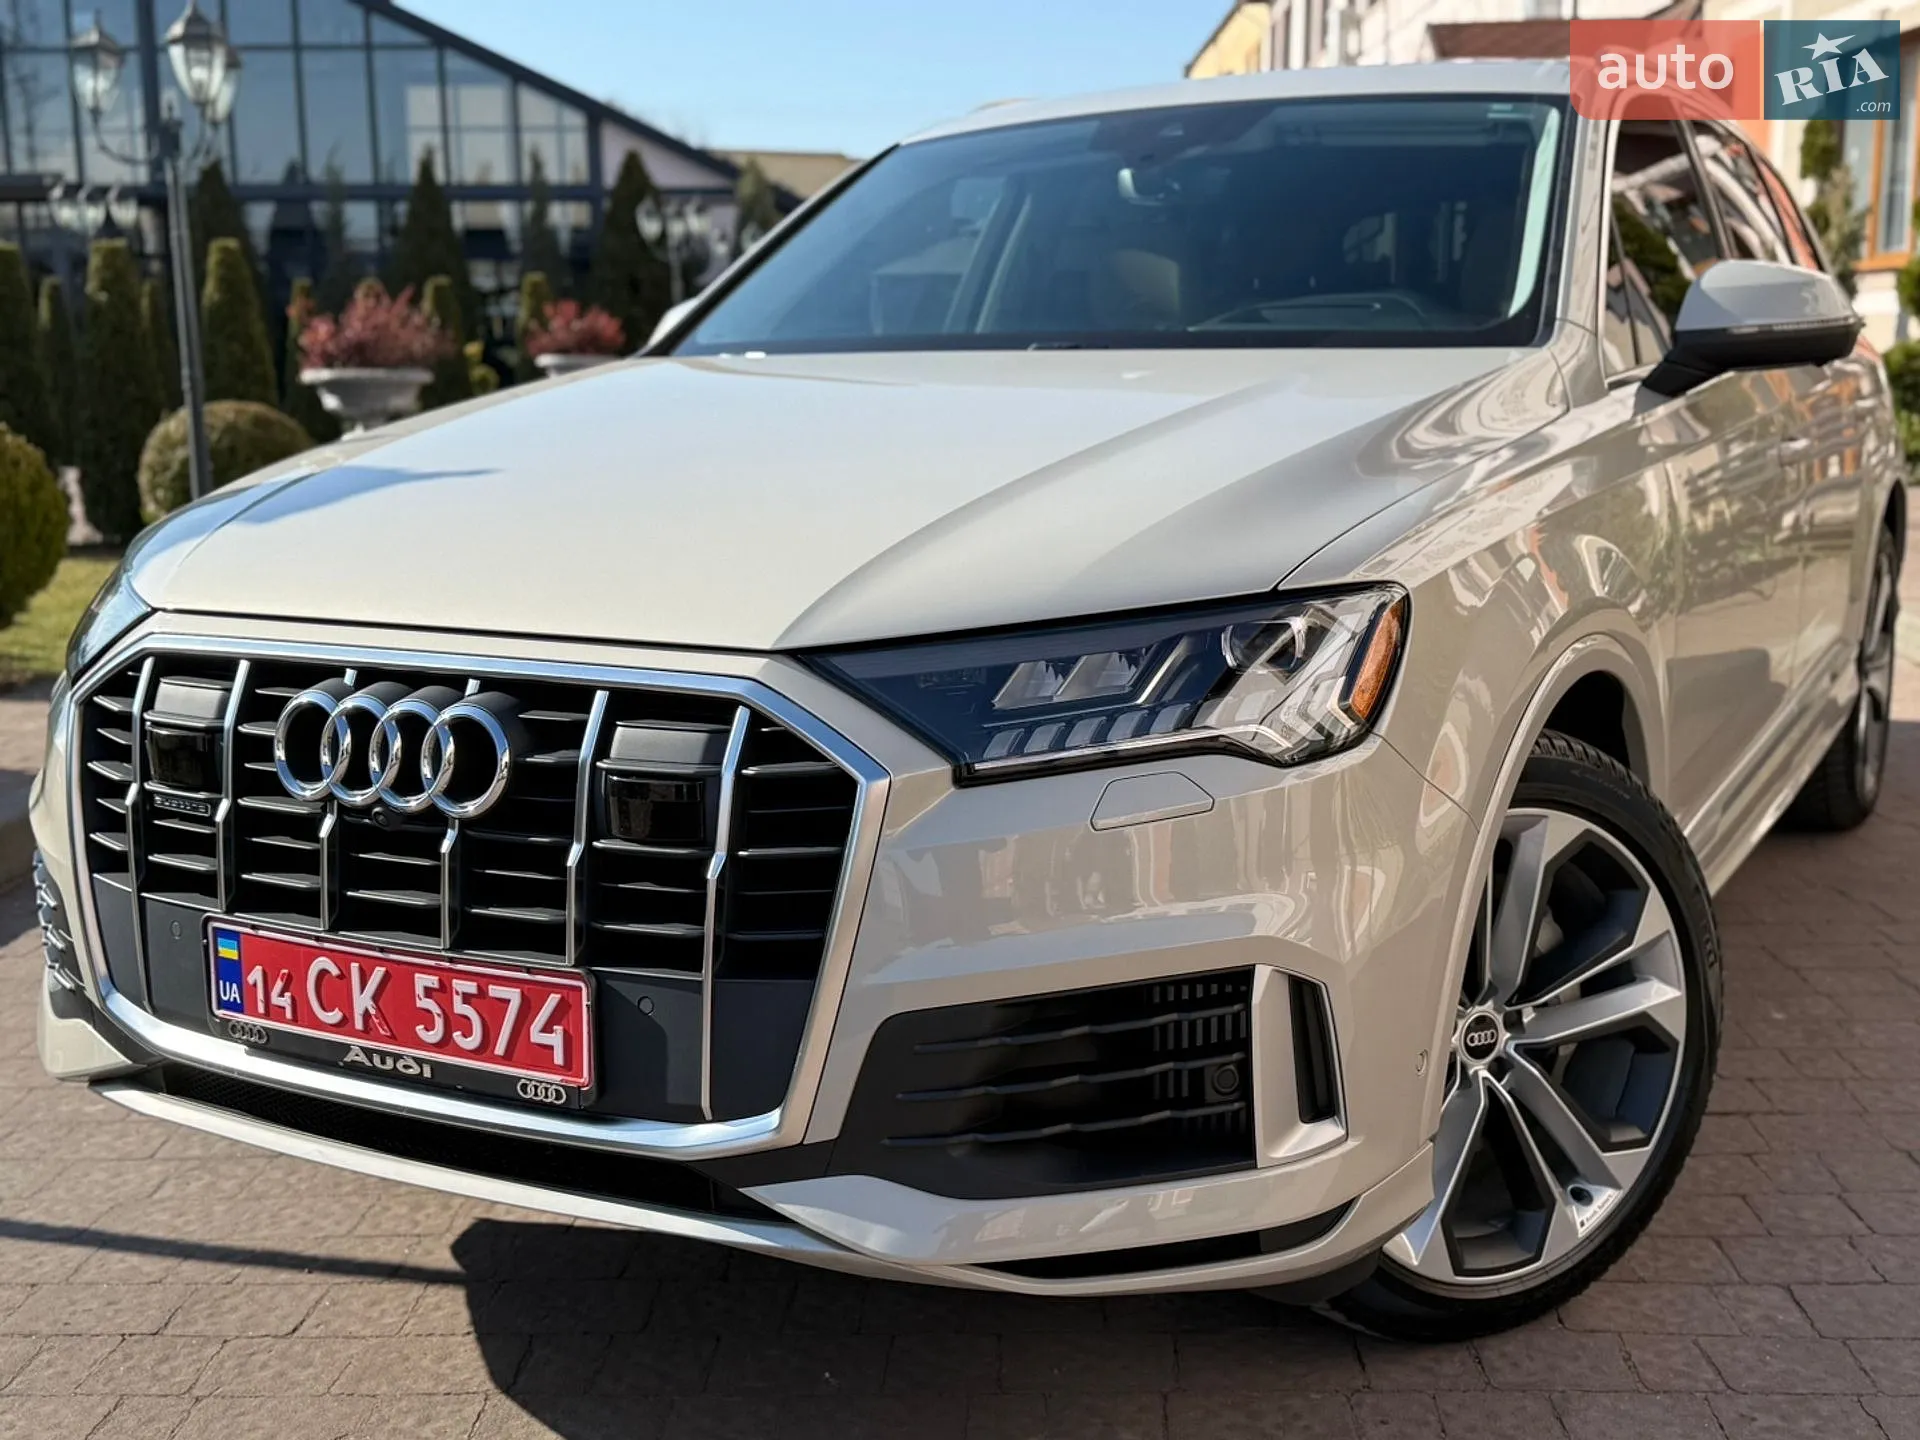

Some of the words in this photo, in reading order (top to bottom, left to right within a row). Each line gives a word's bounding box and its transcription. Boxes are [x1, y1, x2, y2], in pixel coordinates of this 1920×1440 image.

[219, 982, 241, 1004] UA
[247, 965, 293, 1019] 14
[306, 956, 391, 1037] CK
[414, 972, 565, 1066] 5574
[343, 1046, 433, 1079] Audi
